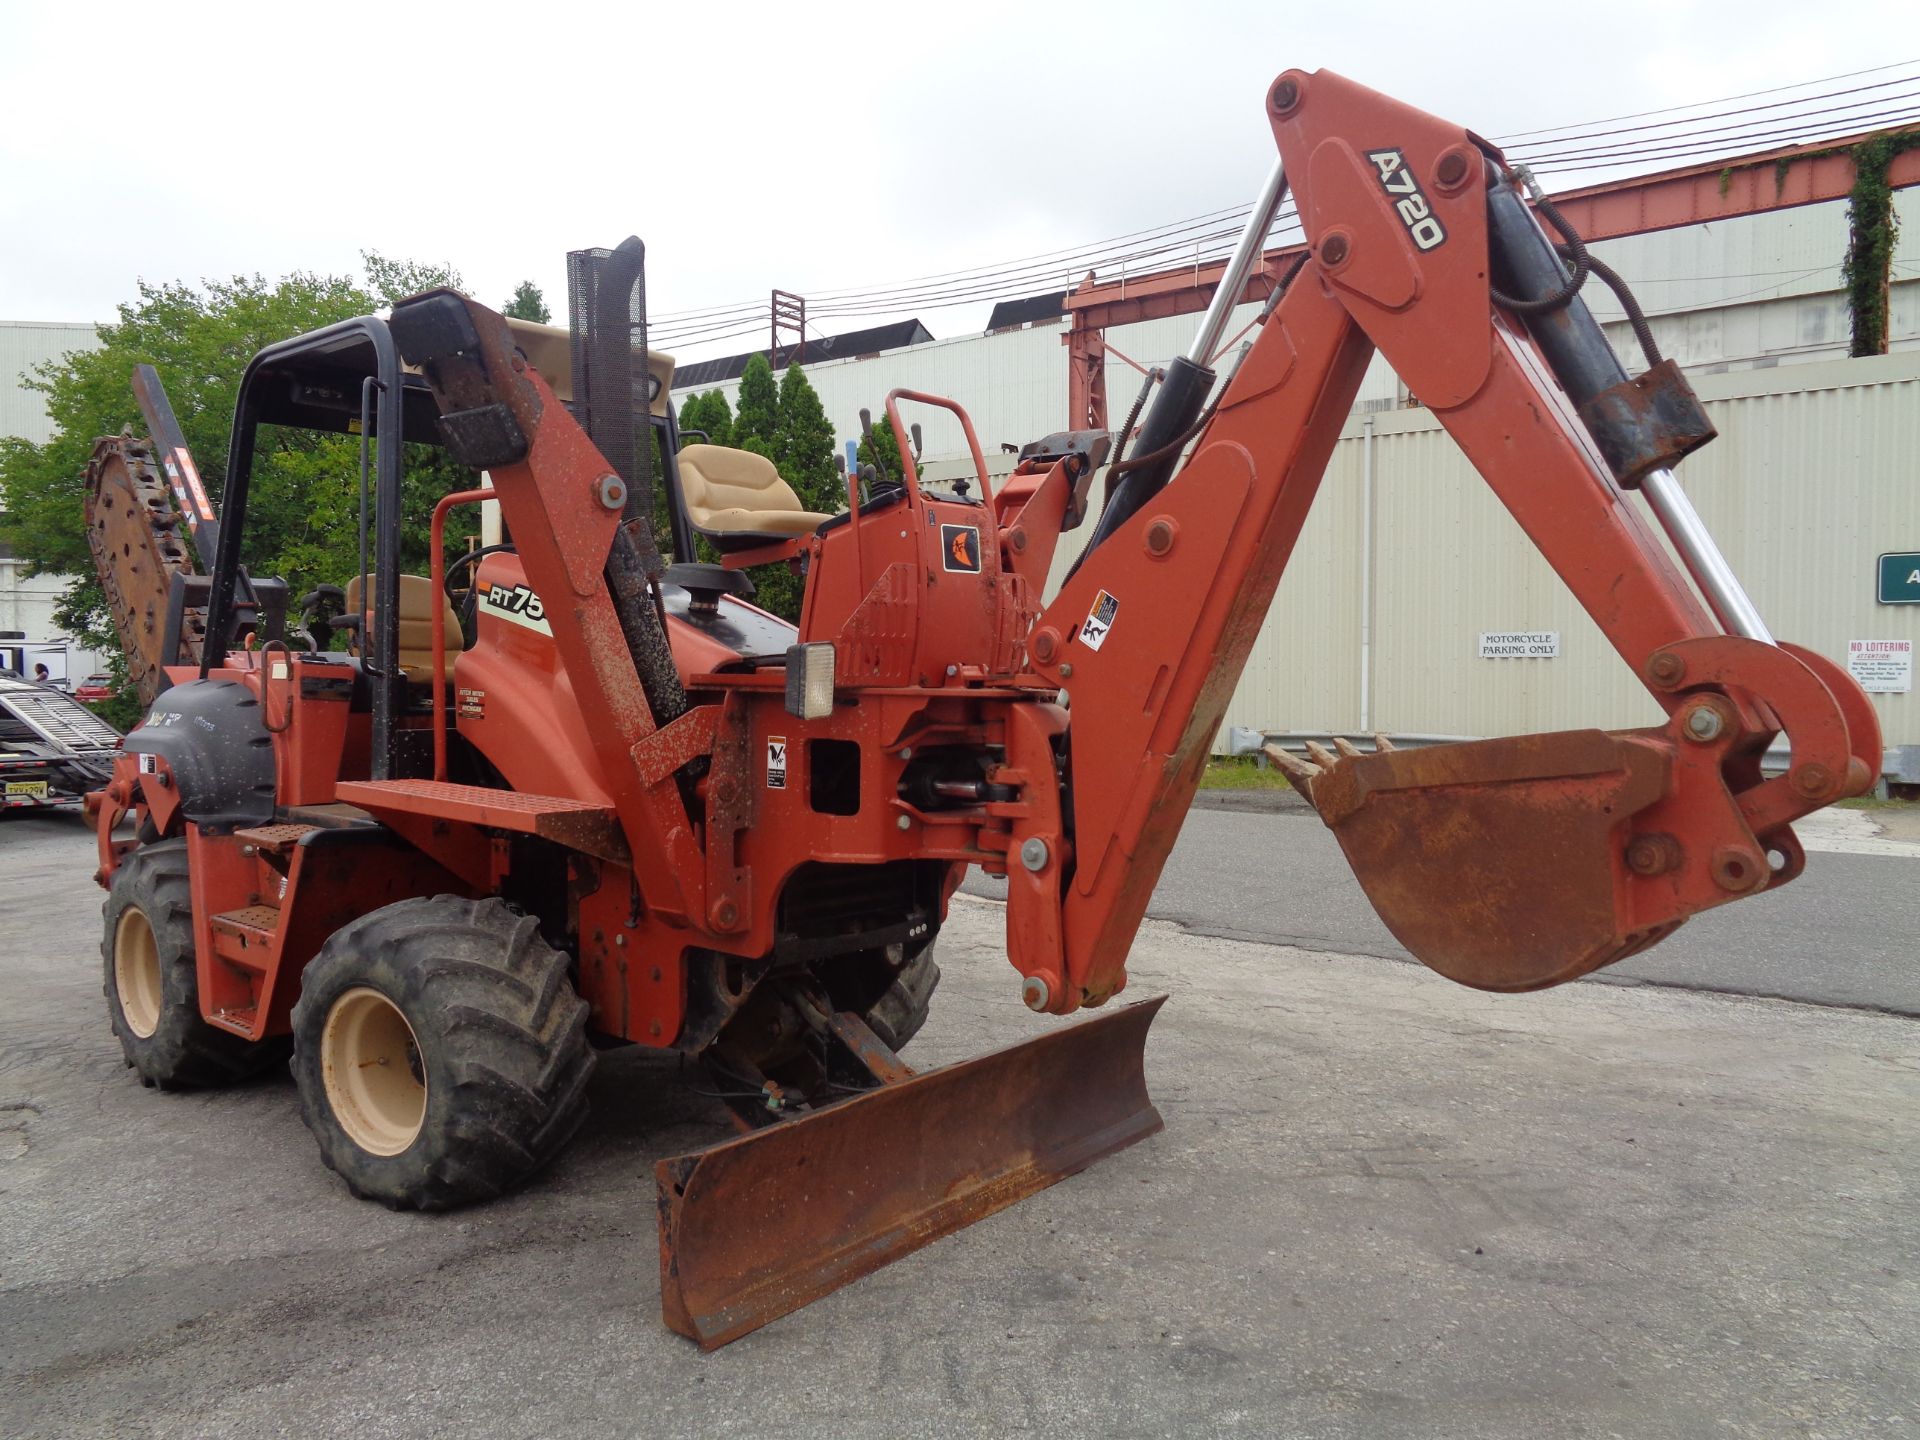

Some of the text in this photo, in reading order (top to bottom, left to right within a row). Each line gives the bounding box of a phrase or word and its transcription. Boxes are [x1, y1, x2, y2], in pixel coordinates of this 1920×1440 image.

[1369, 152, 1443, 249] A720
[489, 586, 544, 618] RT75
[1486, 634, 1552, 644] MOTORCYCLE
[1483, 645, 1556, 654] PARKING ONLY
[1850, 642, 1910, 652] NO LOITERING
